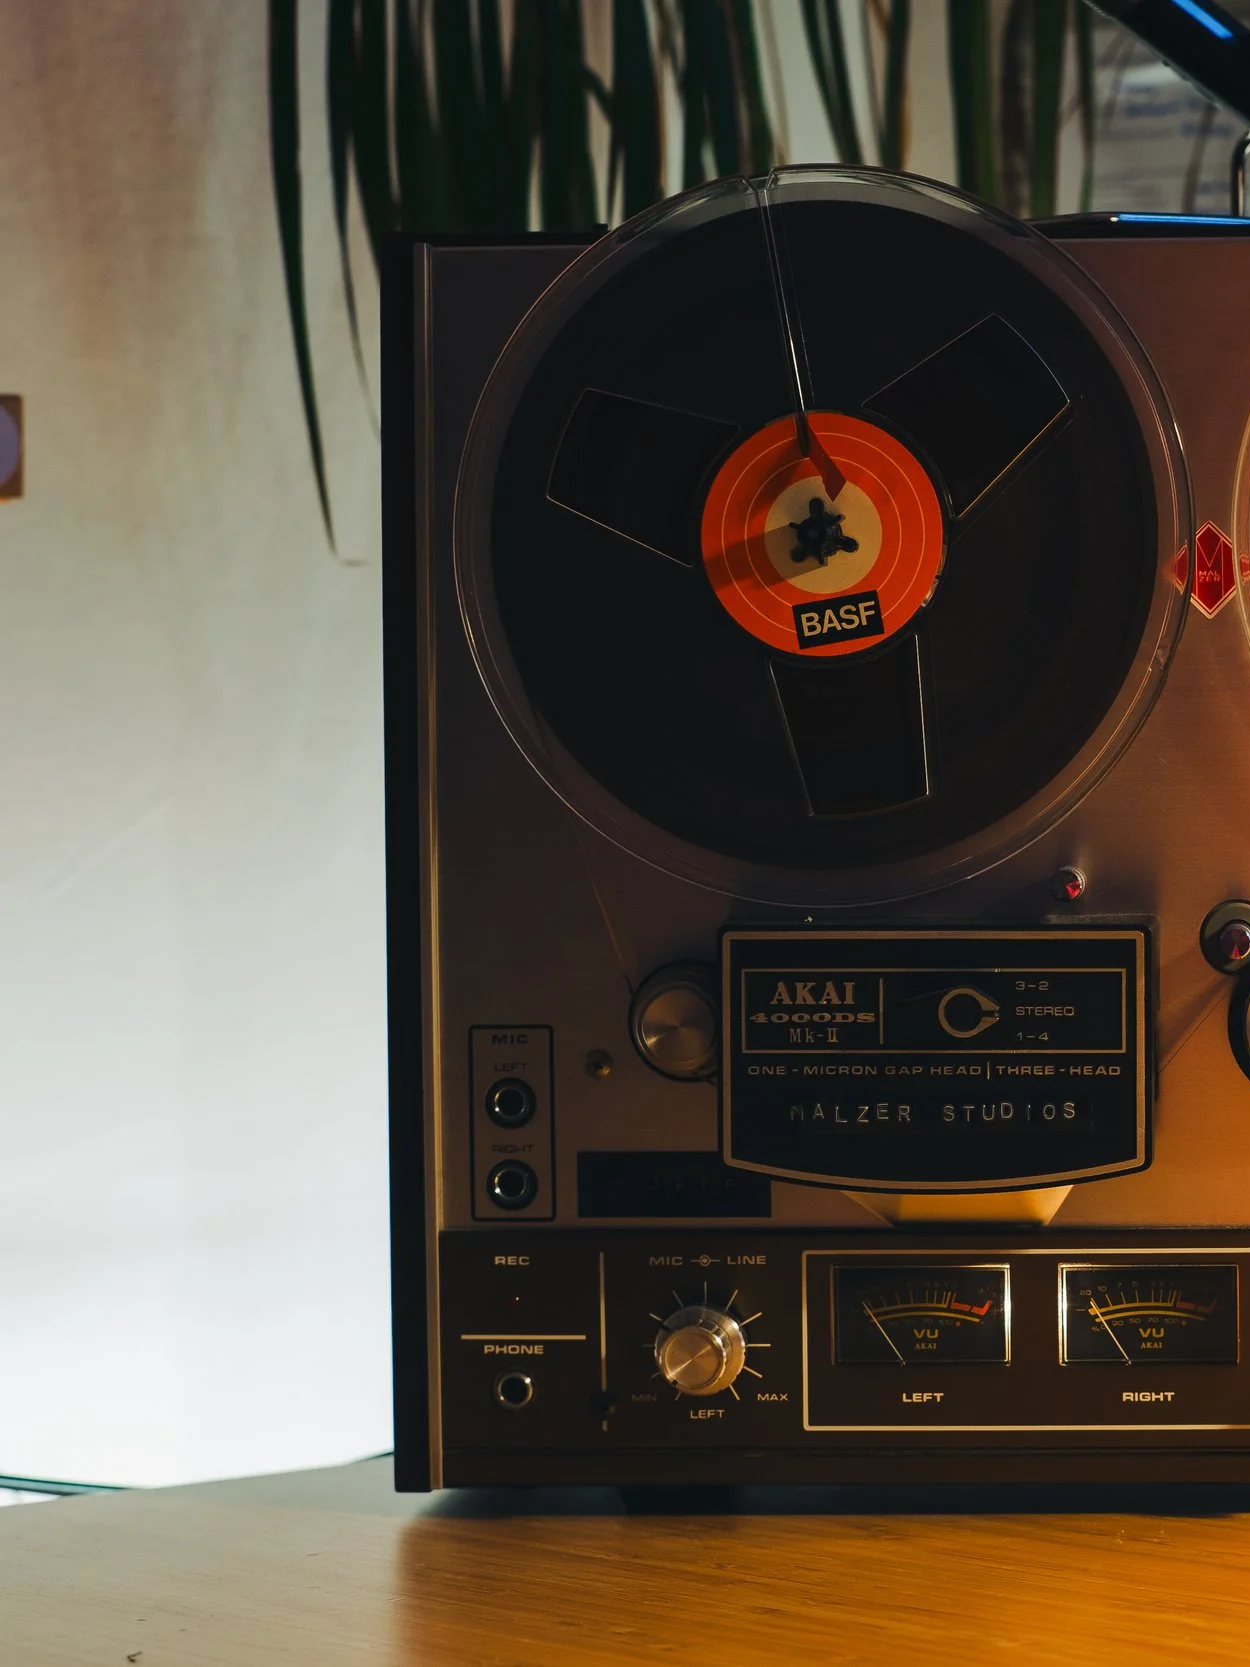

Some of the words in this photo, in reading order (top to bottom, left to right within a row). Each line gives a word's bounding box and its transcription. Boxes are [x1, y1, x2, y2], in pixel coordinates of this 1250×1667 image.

[800, 600, 875, 637] BASF
[770, 981, 856, 1005] AKAI
[1015, 1006, 1075, 1017] STEREO
[749, 1012, 876, 1024] 4000DS
[491, 1034, 529, 1045] MIC
[493, 1062, 529, 1073] LEFT
[884, 1065, 923, 1076] GAP
[930, 1065, 982, 1076] HEAD
[790, 1103, 912, 1124] MALZER
[943, 1101, 1076, 1123] STUDIOS
[491, 1143, 535, 1154] RIGHT
[494, 1256, 530, 1266] REC
[649, 1256, 683, 1266] MIC
[727, 1255, 767, 1266] LINE
[914, 1328, 938, 1338] VU
[1139, 1327, 1164, 1338] VU
[483, 1345, 544, 1355] PHONE
[632, 1393, 657, 1402] MIN
[757, 1393, 788, 1401] MAX
[902, 1392, 944, 1403] LEFT
[1122, 1391, 1175, 1402] RIGHT
[690, 1409, 725, 1419] LEFT
